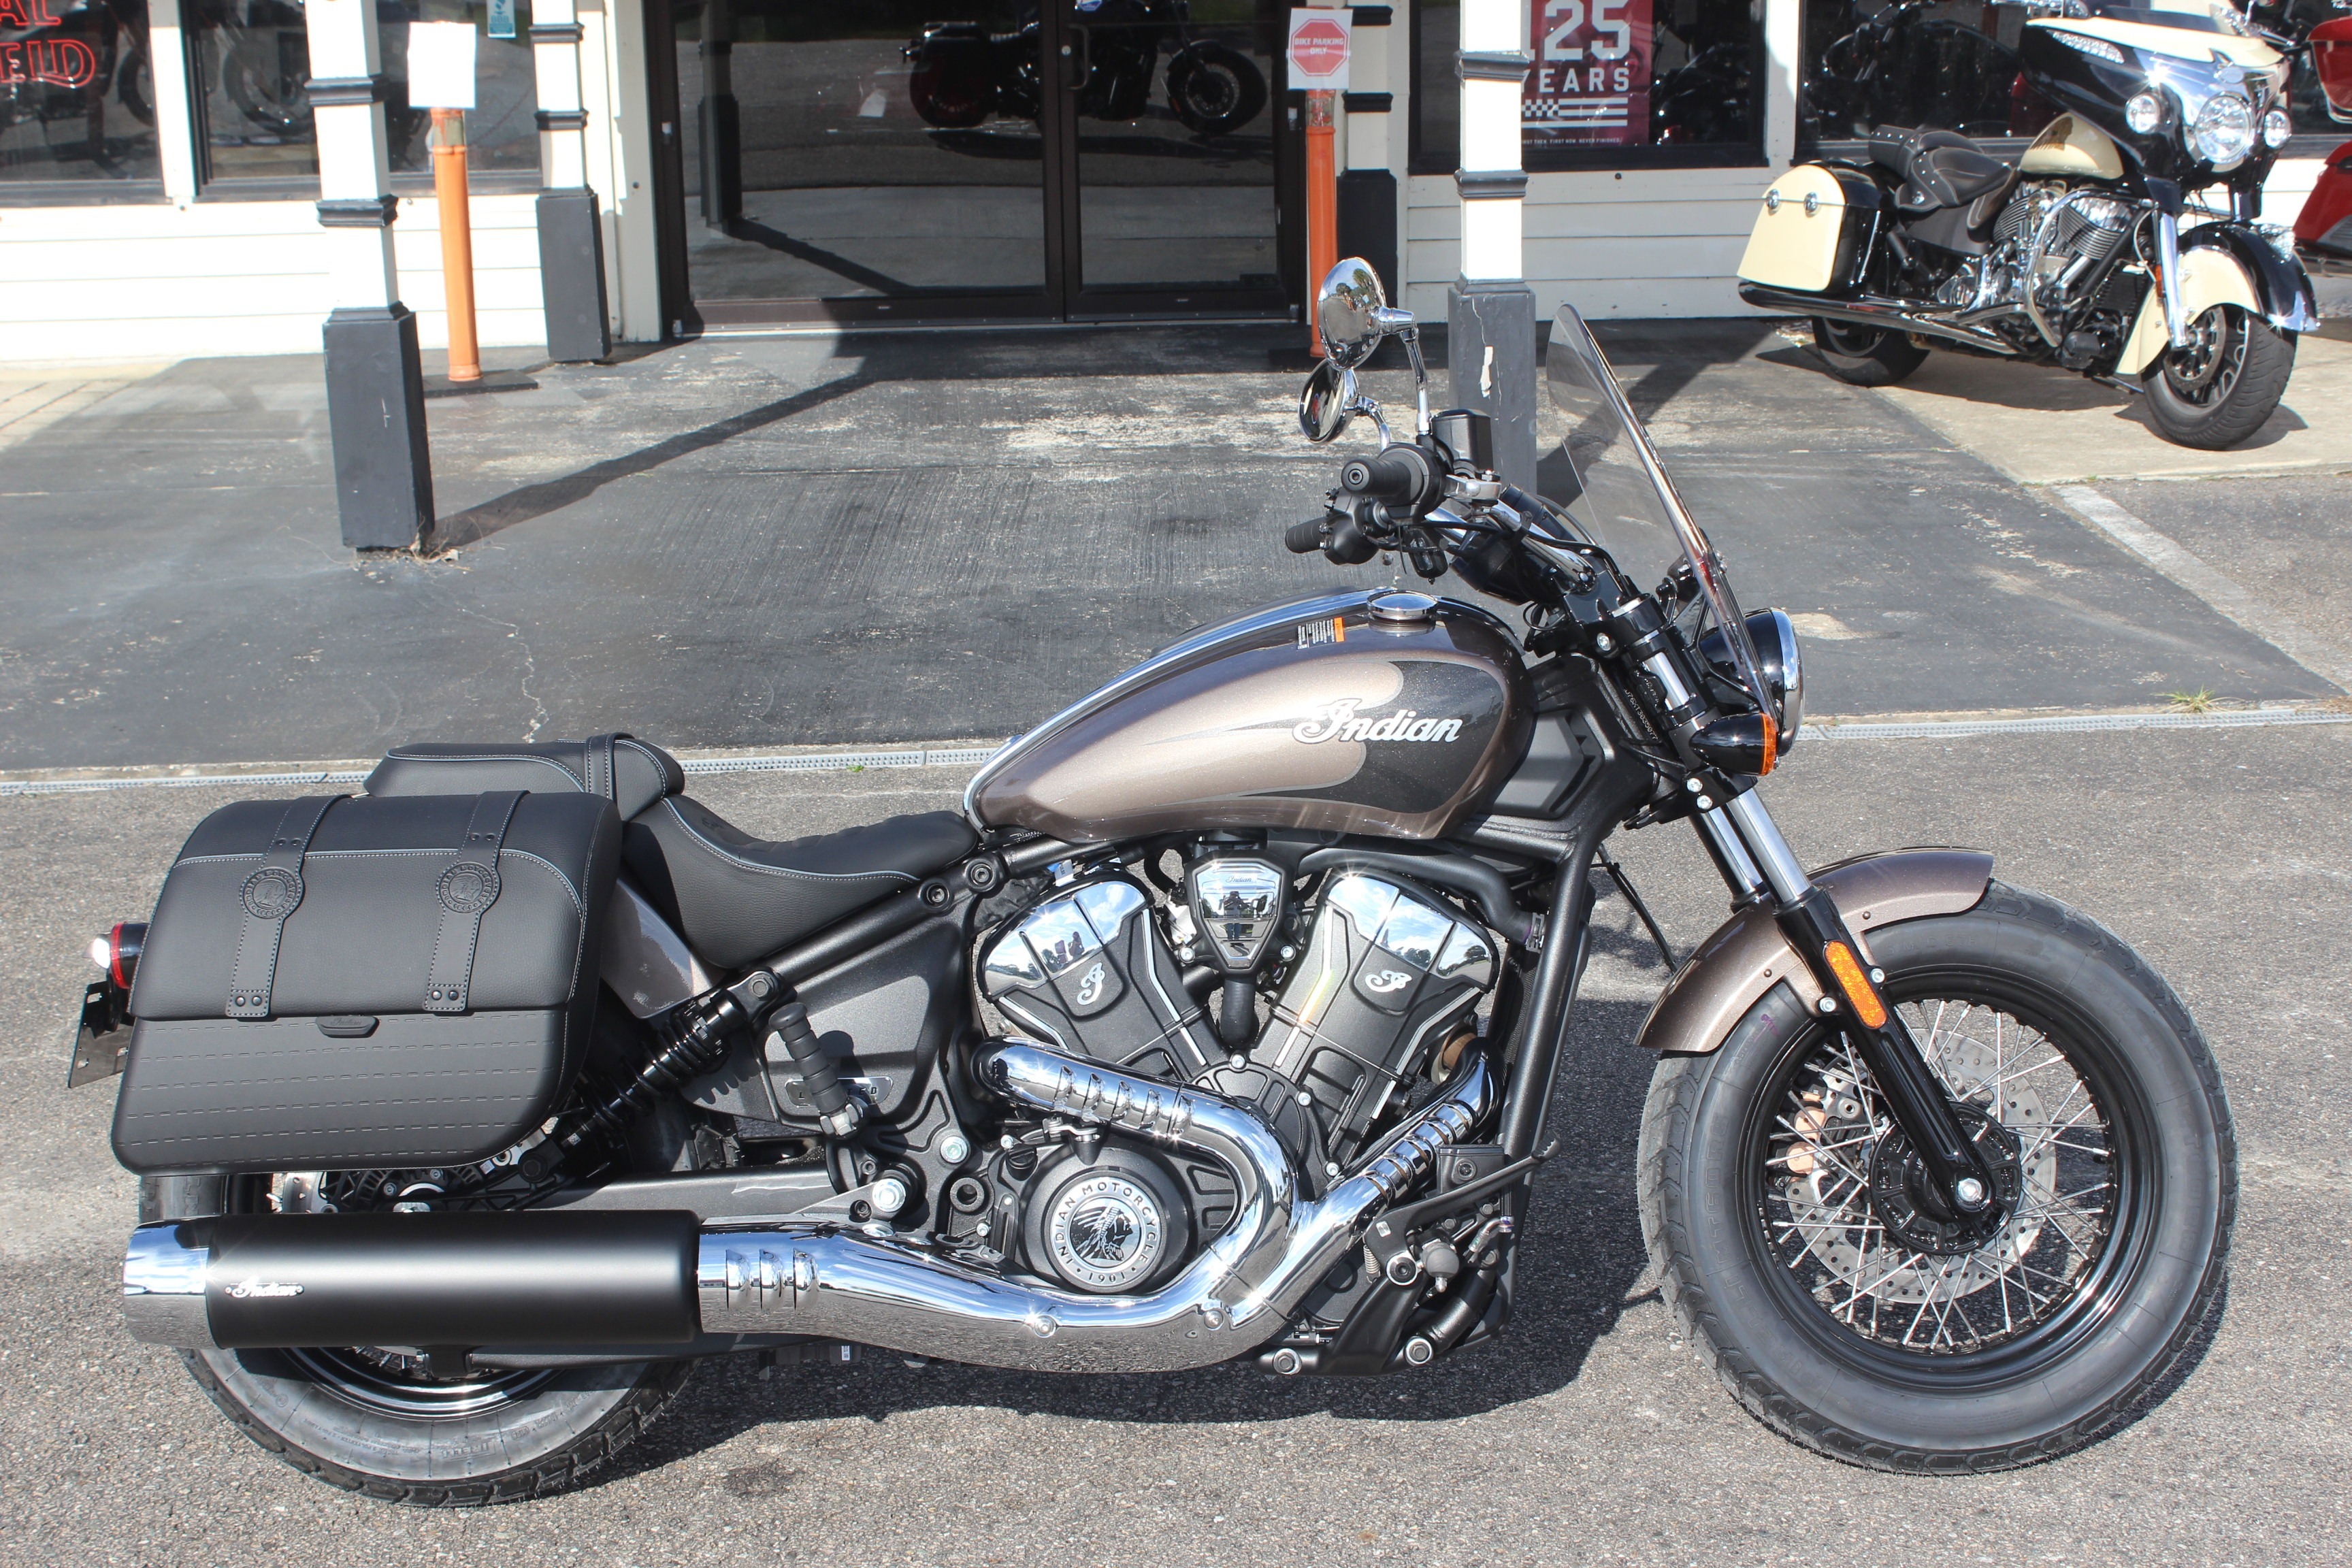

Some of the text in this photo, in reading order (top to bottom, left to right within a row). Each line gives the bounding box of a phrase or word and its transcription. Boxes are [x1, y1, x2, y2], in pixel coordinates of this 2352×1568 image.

[1294, 37, 1344, 46] BIKE PARKING
[1309, 47, 1327, 55] ONLY
[1292, 698, 1464, 745] Indian
[1225, 875, 1252, 883] Indian
[1056, 1181, 1157, 1265] INDIAN MOTORCYCLE
[1089, 1271, 1126, 1282] 1901
[231, 1276, 297, 1298] Indian
